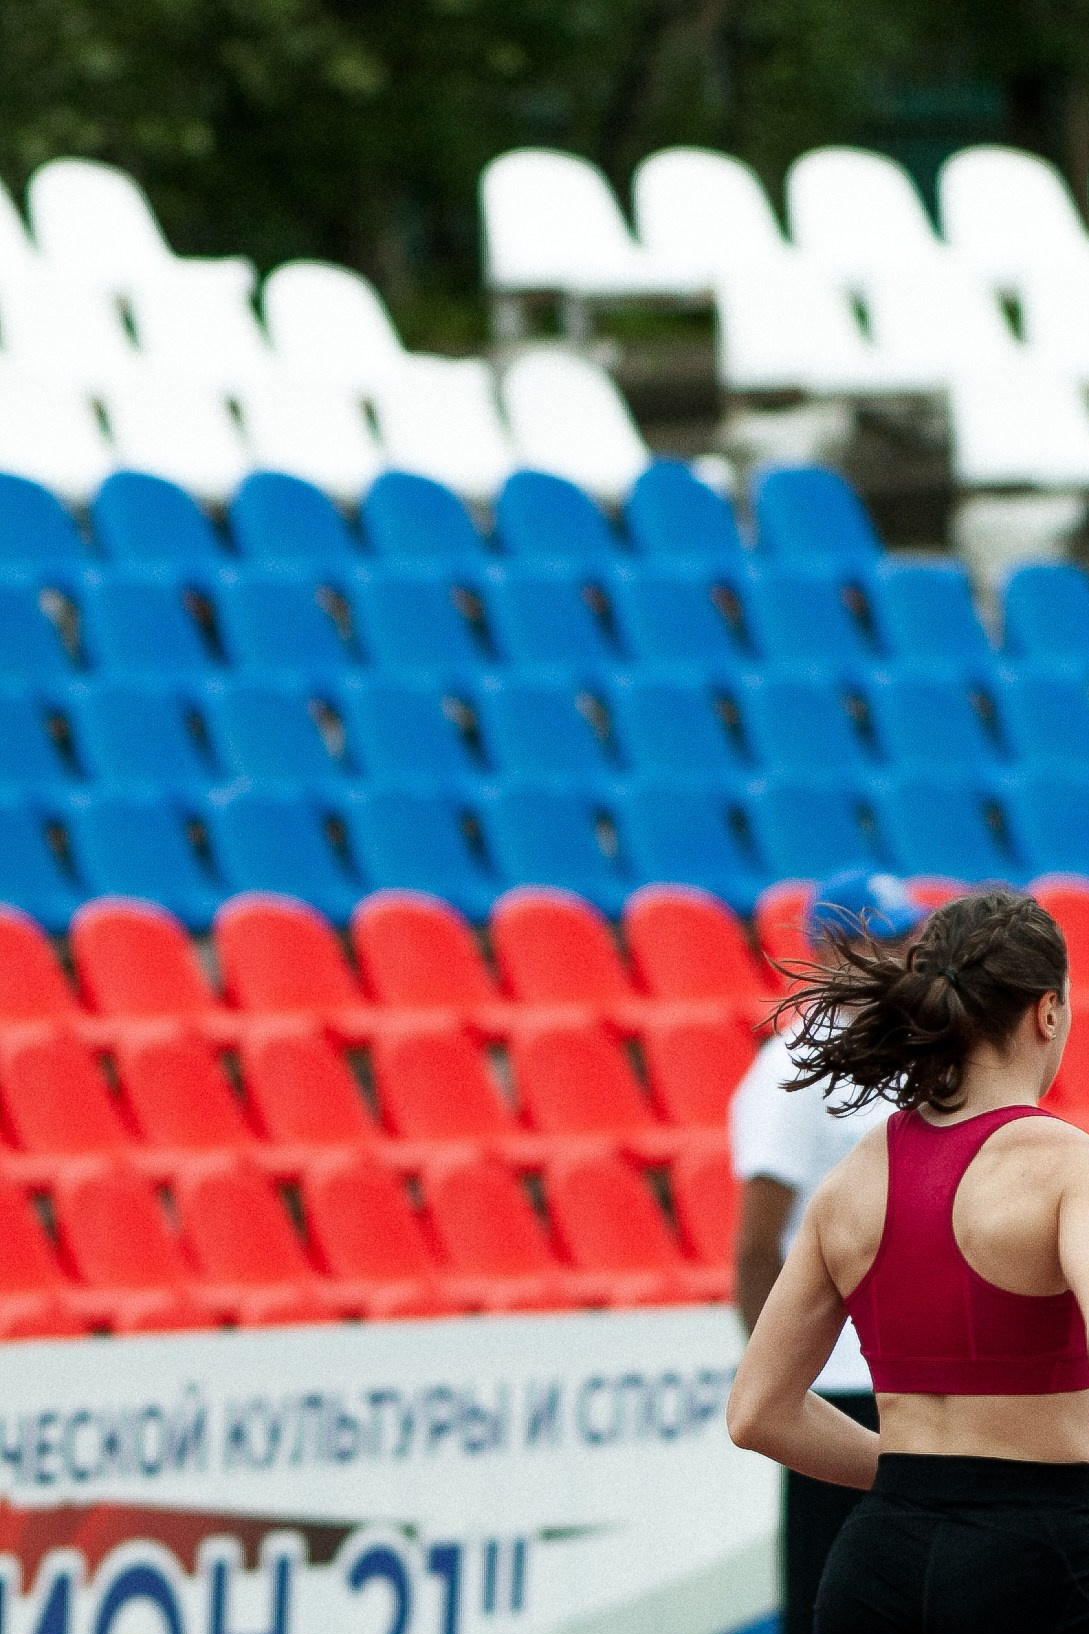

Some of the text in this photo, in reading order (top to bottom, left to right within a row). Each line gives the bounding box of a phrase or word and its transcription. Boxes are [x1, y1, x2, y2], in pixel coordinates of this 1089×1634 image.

[222, 1382, 507, 1471] КУЛЬТУРЫ
[525, 1376, 561, 1451] И
[576, 1366, 738, 1446] СПОР
